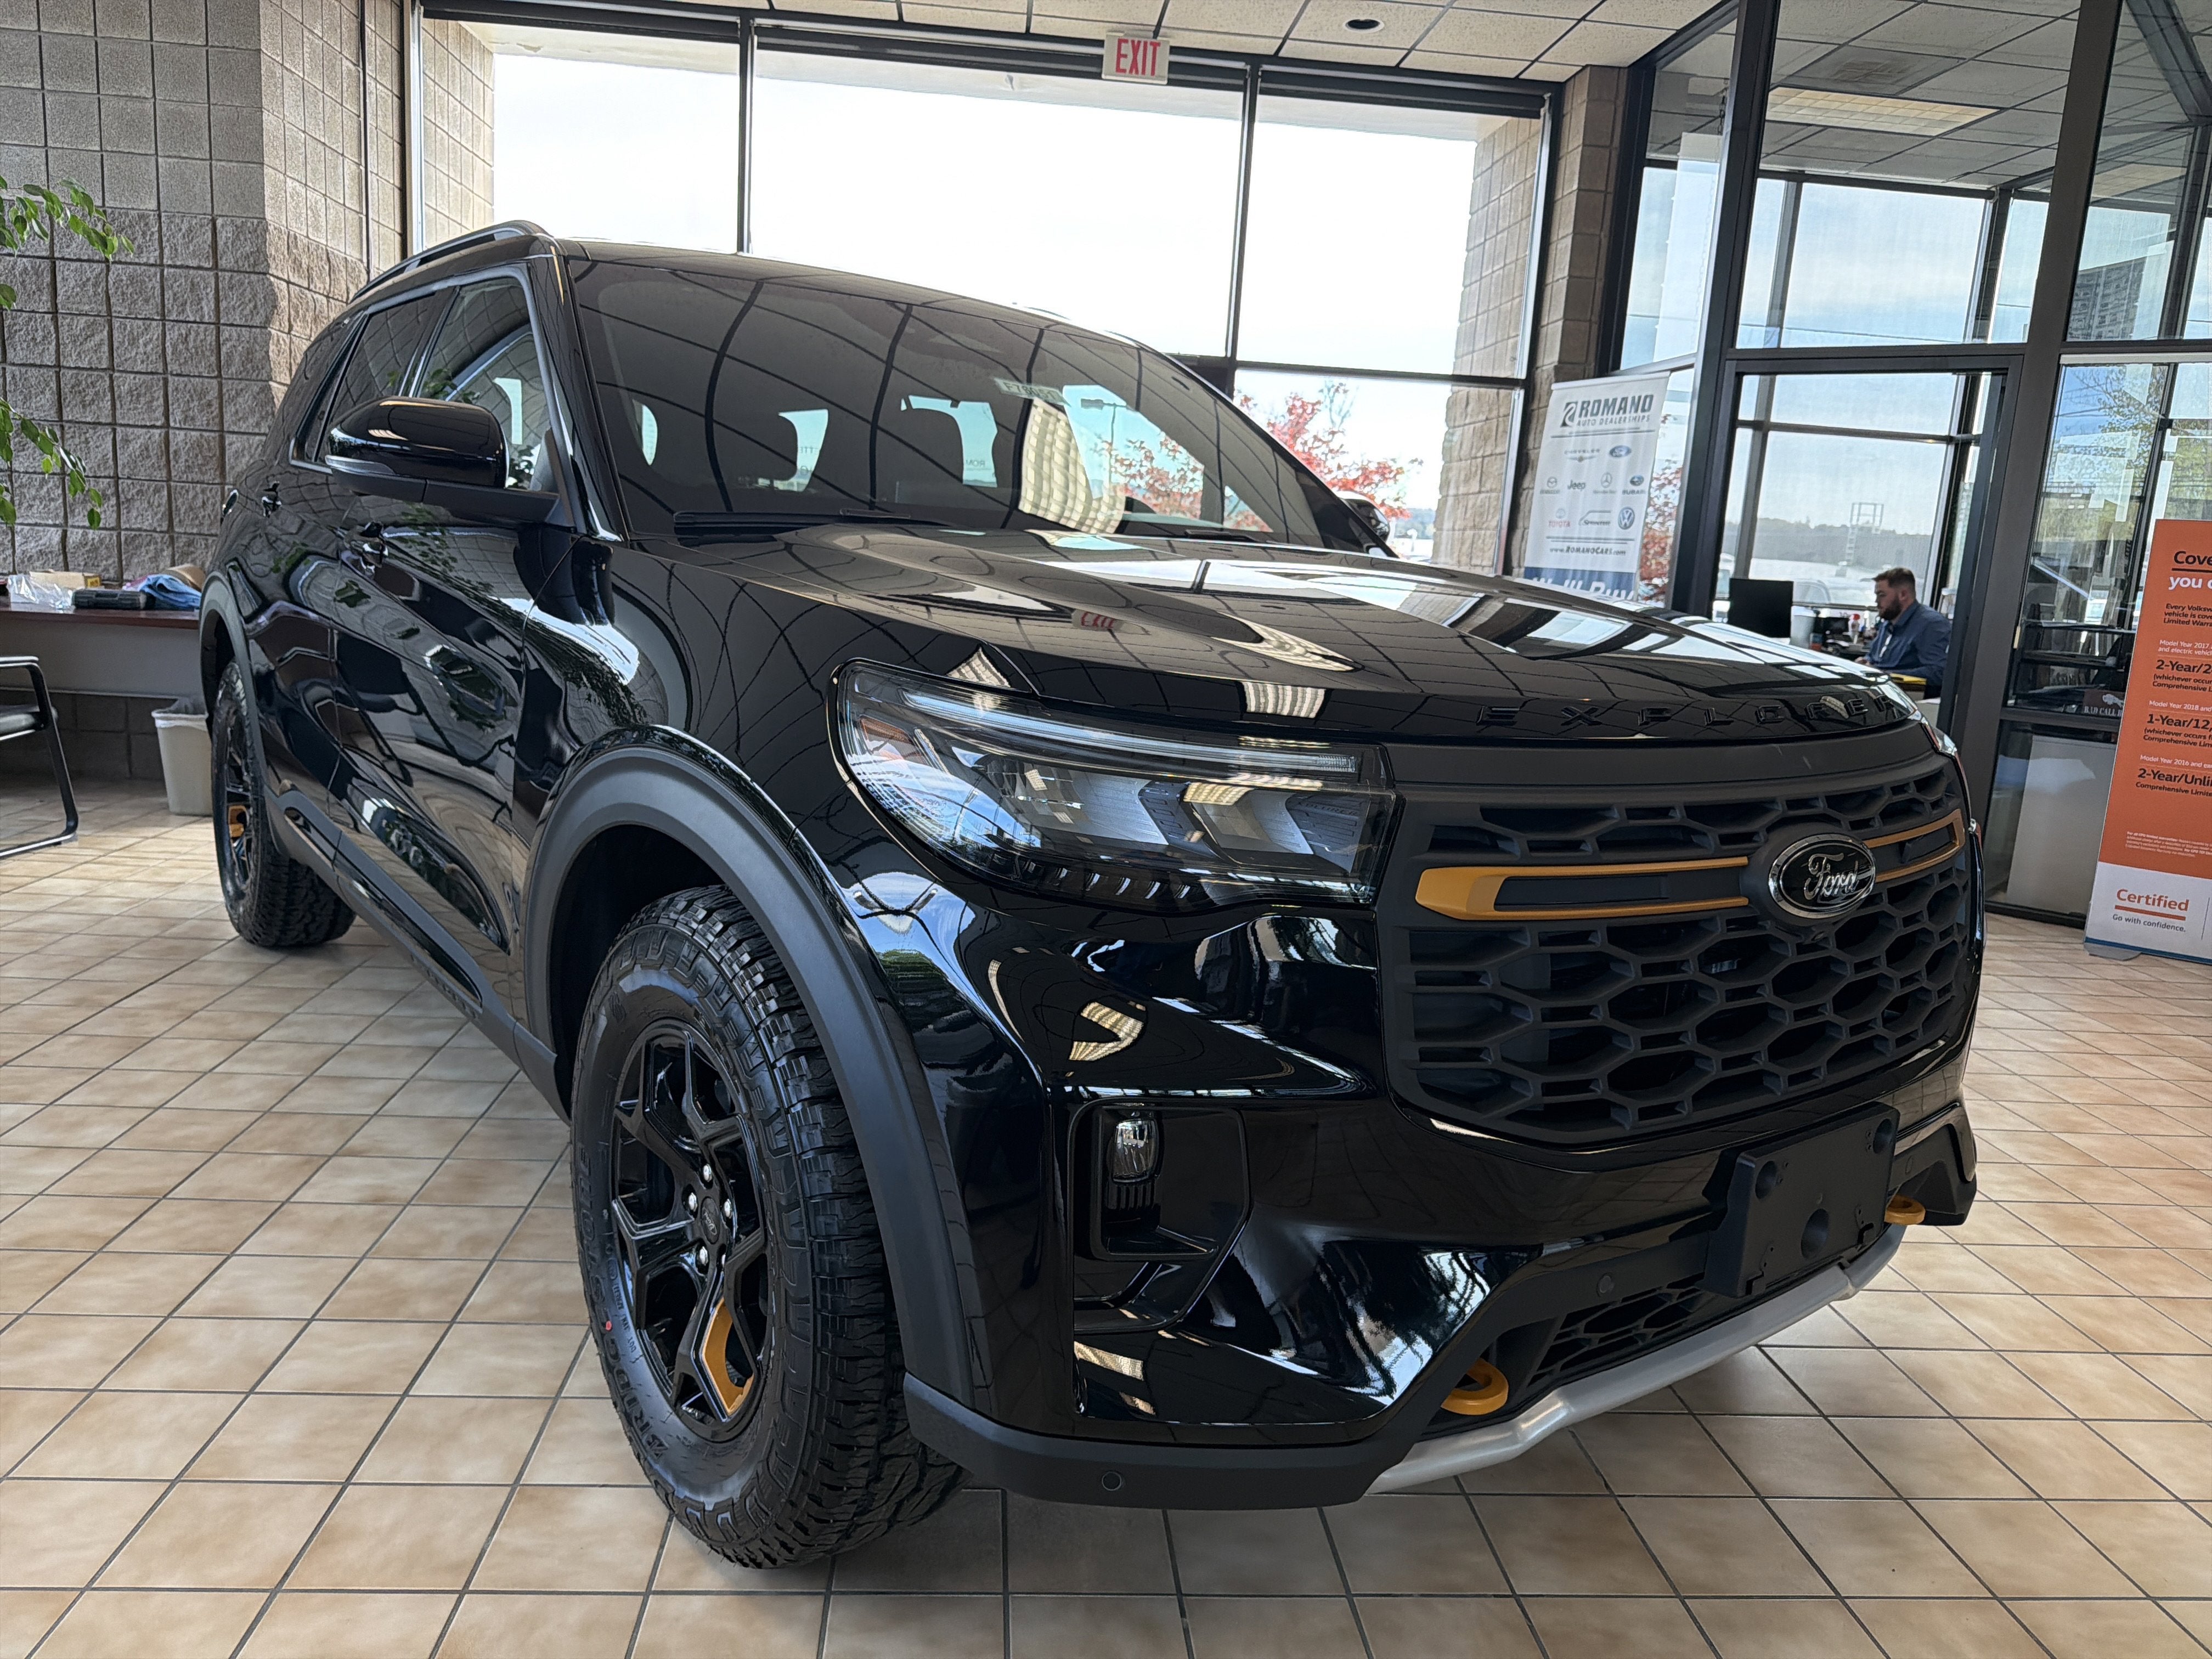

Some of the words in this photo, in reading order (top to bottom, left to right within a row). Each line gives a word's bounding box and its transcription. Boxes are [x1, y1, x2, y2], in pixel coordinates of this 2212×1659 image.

[1115, 38, 1161, 76] EXIT
[1578, 394, 1654, 418] ROMANO
[1576, 419, 1596, 427] AUTO
[1599, 415, 1651, 426] DEALERSHIPS
[1567, 479, 1586, 492] Jeep
[2168, 576, 2203, 590] you
[2164, 617, 2191, 625] Limited
[2155, 659, 2212, 674] 2-Year/2
[2153, 674, 2192, 682] (whichever
[2152, 681, 2207, 691] Comprehensive
[1476, 694, 1899, 726] EXPLORER
[2084, 706, 2098, 714] BAD
[2144, 727, 2182, 737] (whichever
[2143, 735, 2197, 747] Comprehensive
[2137, 768, 2212, 787] 2-Year/Unli
[2135, 782, 2189, 794] Comprehensive
[1803, 852, 1859, 901] Ford
[2117, 889, 2190, 912] Certified
[2143, 920, 2186, 932] confidence.
